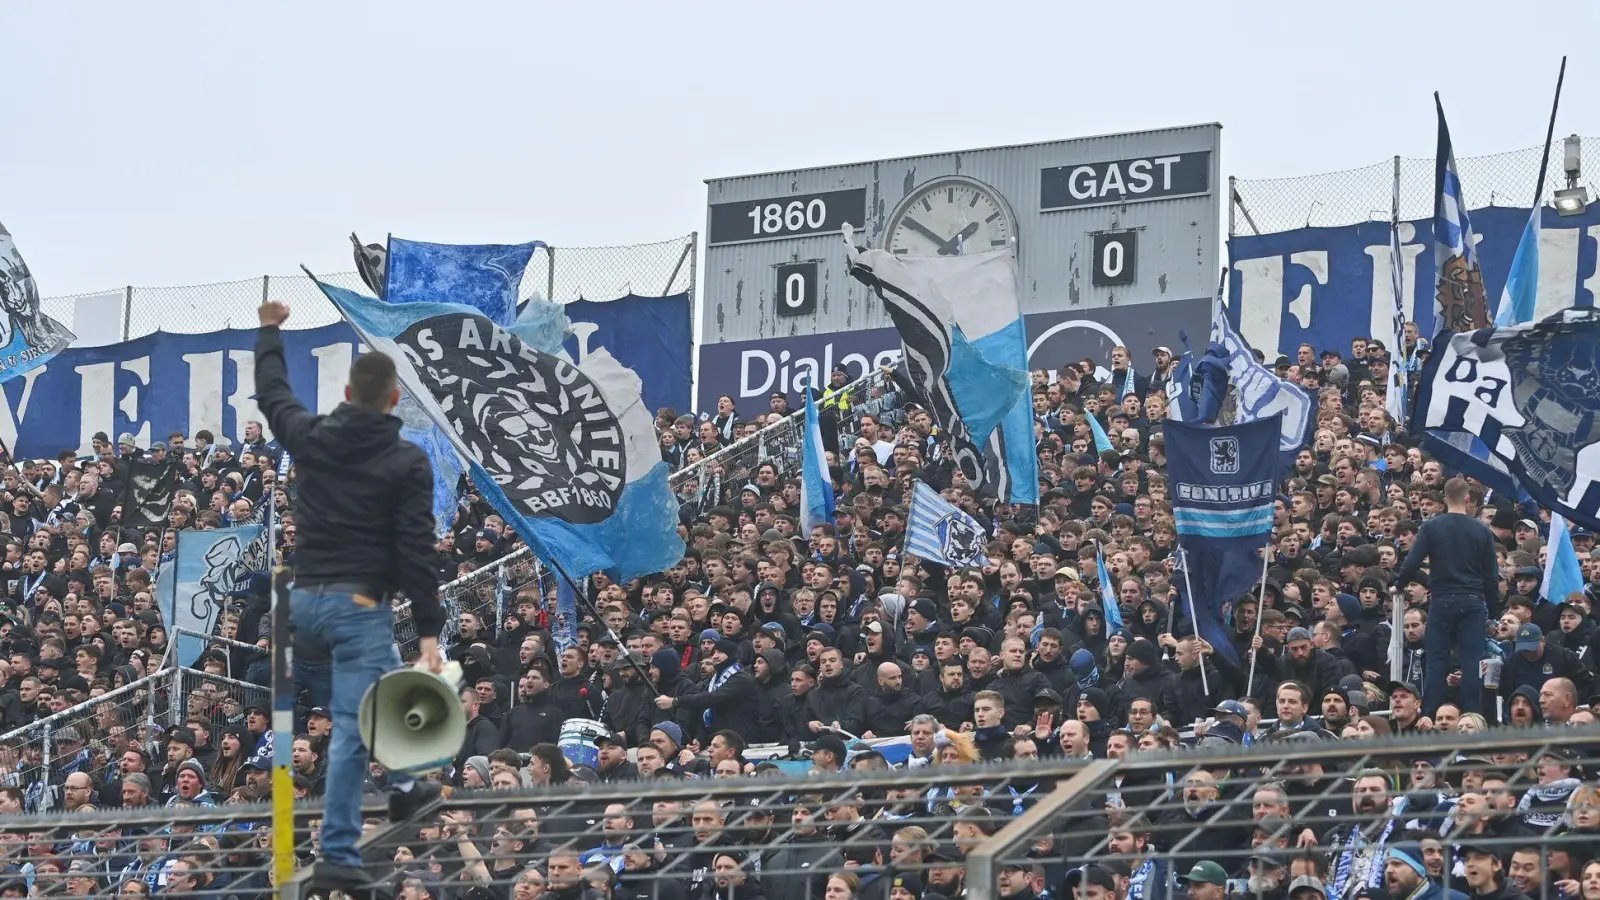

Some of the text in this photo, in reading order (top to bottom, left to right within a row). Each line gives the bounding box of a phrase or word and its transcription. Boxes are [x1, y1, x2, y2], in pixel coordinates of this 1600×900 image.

[1068, 156, 1181, 200] GAST
[748, 198, 827, 235] 1860
[1103, 240, 1125, 278] 0
[786, 273, 805, 308] 0
[523, 485, 611, 513] BBF1860
